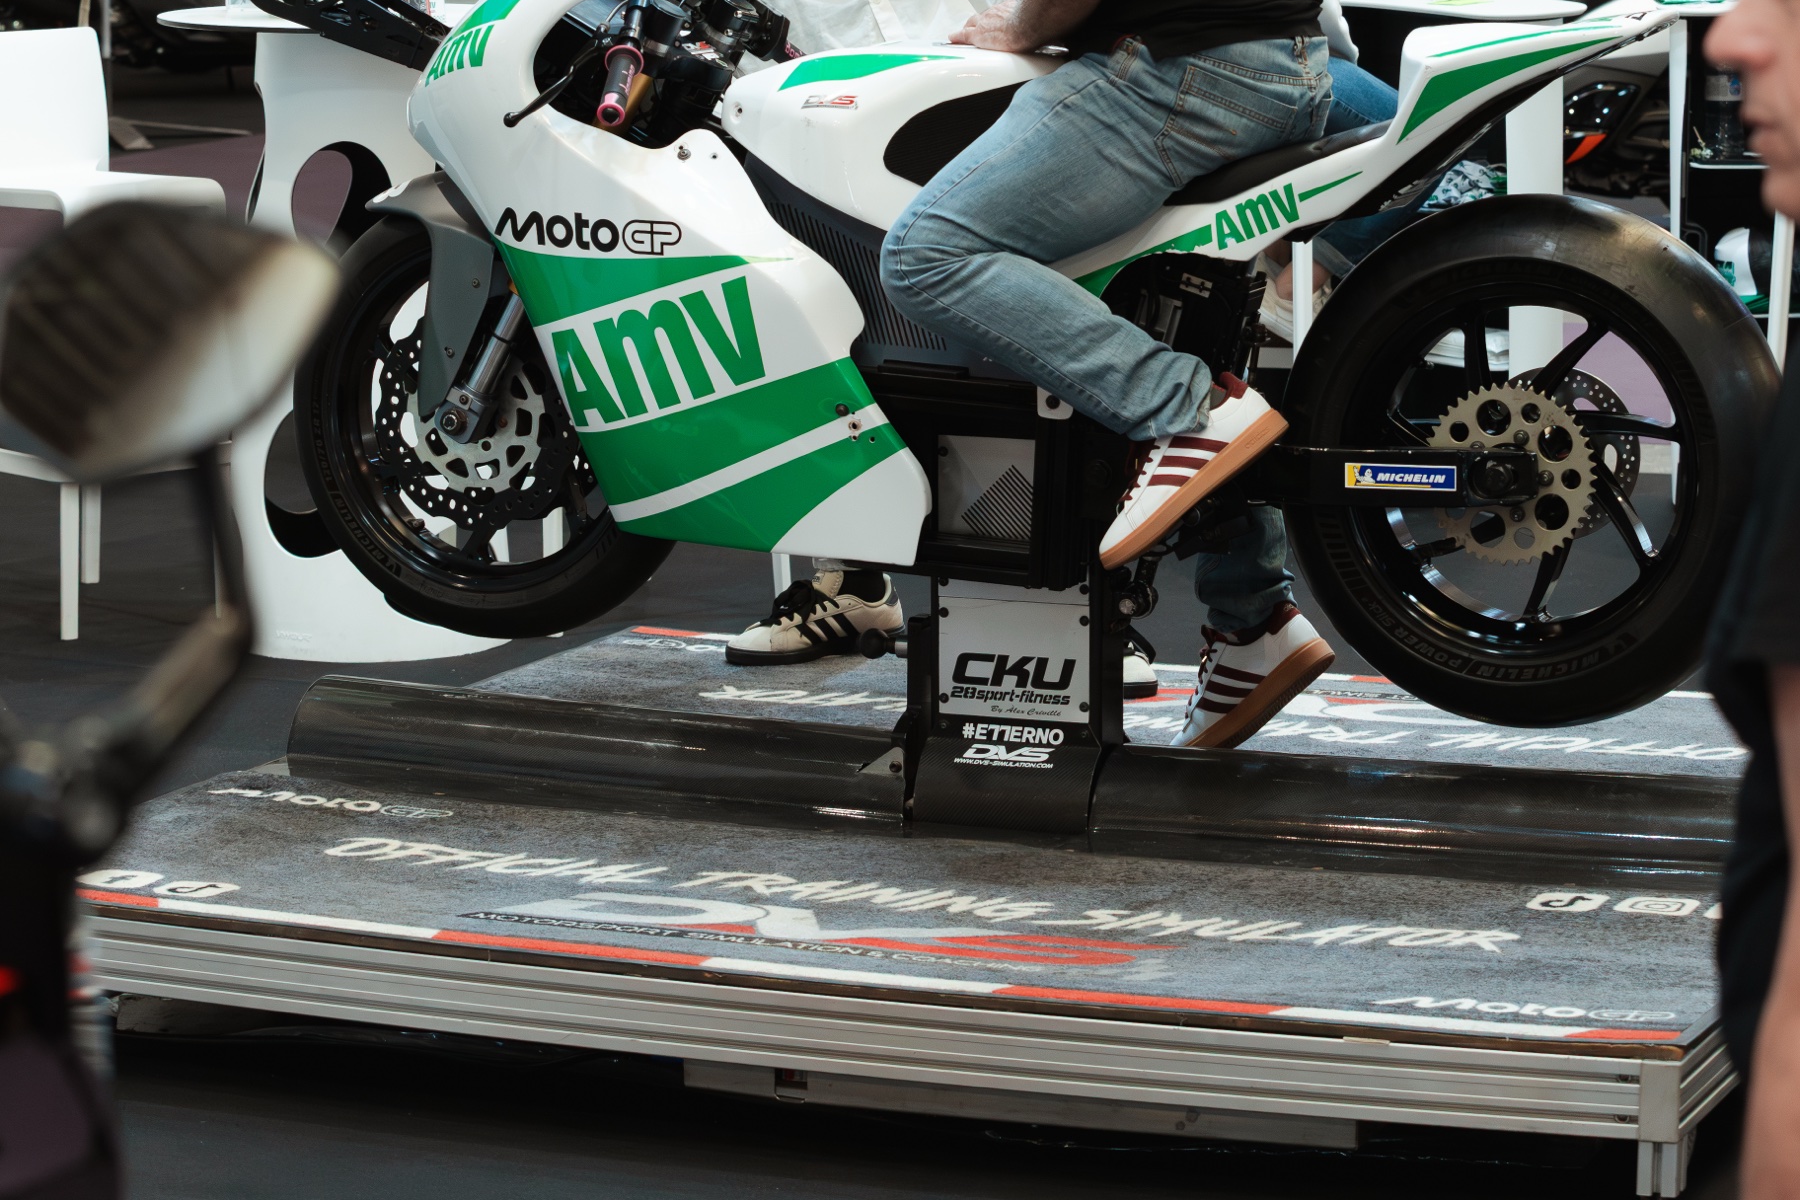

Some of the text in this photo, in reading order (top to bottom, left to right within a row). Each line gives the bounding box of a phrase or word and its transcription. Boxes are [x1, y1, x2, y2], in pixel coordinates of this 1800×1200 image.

[424, 24, 495, 88] AMV
[1216, 183, 1300, 250] AMV
[550, 275, 766, 430] AMV
[1376, 470, 1447, 484] MICHELIN
[1393, 627, 1463, 668] POWER
[1476, 651, 1600, 679] MICHELIN
[952, 652, 1077, 691] CKU
[990, 704, 1003, 714] By
[953, 757, 1054, 769] WWW.DVS-SIMULATION.COM
[962, 743, 1056, 763] DVS
[324, 837, 1521, 953] OFFICIAL TRAINING SIMULATOR
[469, 912, 681, 938] MOTORSPORT
[685, 932, 863, 956] SIMULATION
[890, 948, 1045, 973] COACHING
